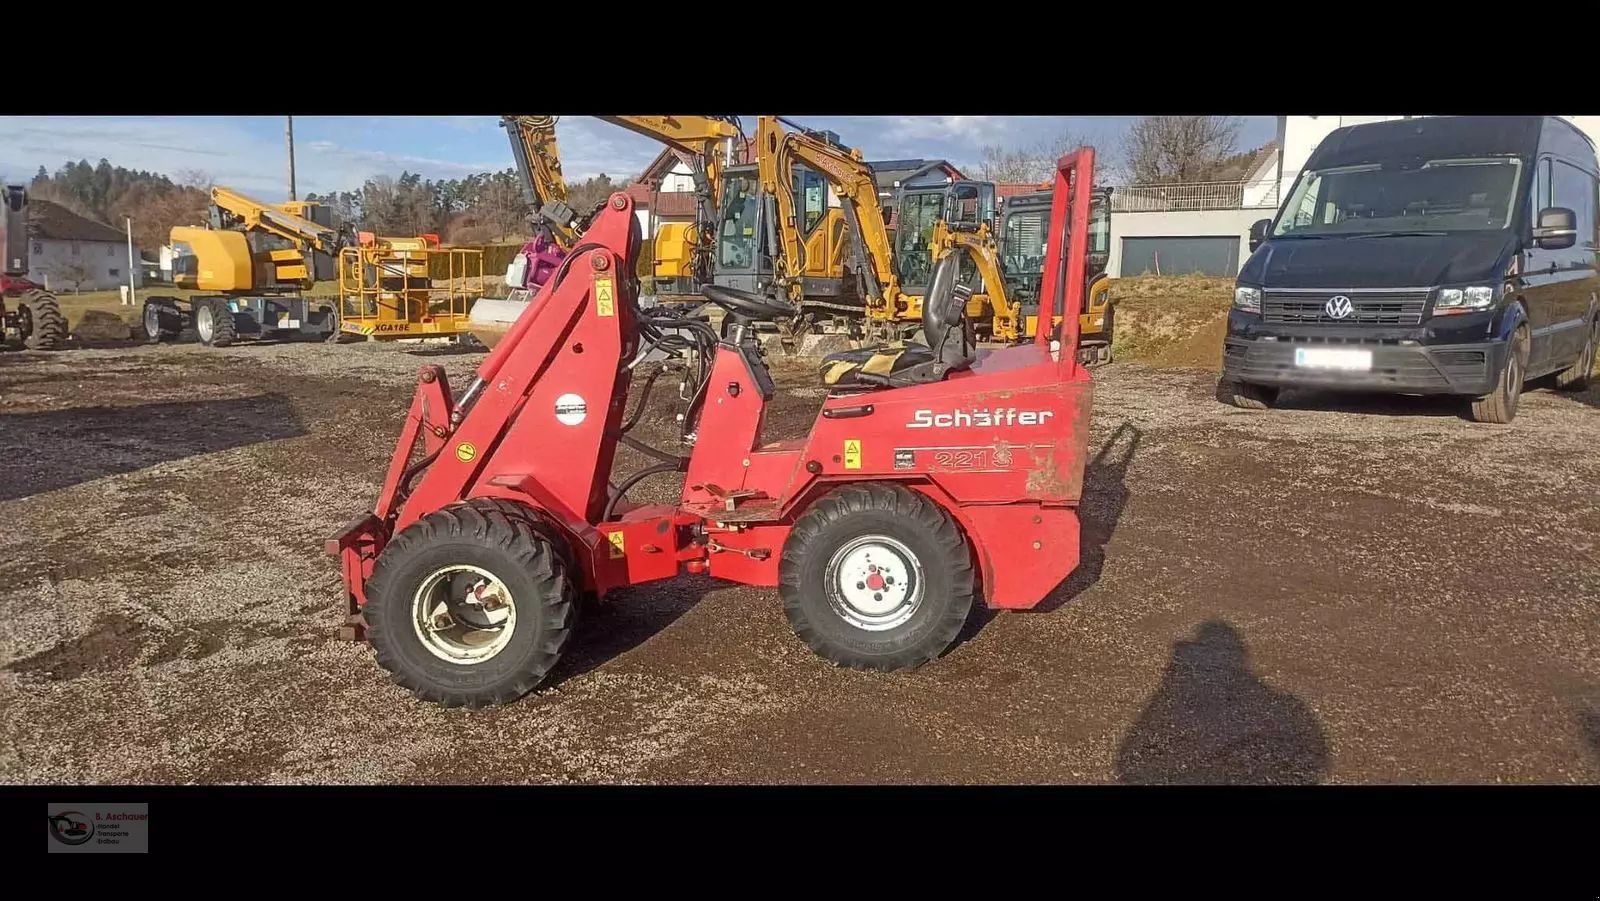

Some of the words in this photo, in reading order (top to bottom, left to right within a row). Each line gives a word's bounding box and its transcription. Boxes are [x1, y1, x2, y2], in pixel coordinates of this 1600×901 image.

[1326, 295, 1352, 319] VW
[374, 323, 410, 332] XGA18E
[906, 408, 1054, 429] Schäffer
